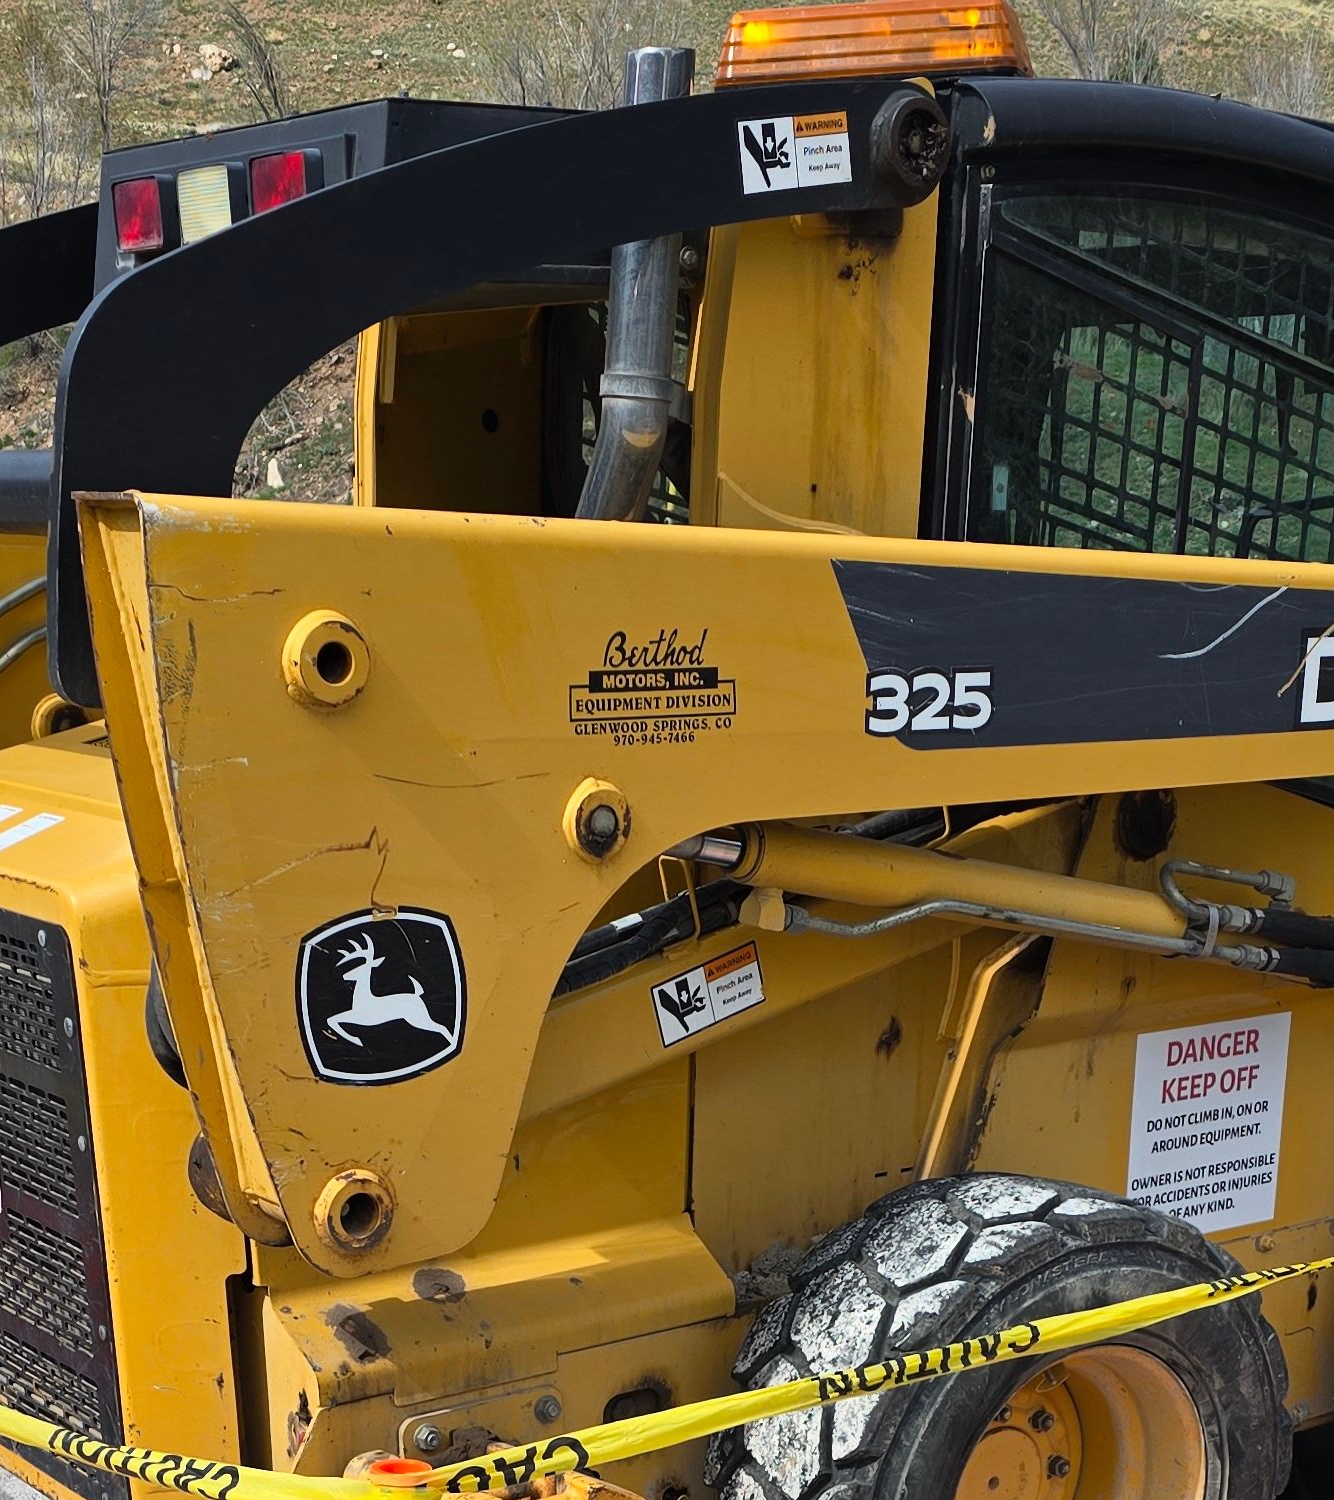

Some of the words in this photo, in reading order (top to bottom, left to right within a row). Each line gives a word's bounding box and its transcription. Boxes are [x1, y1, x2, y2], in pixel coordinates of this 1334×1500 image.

[805, 119, 843, 132] WARNING
[803, 145, 824, 156] Pinch
[826, 143, 843, 154] Area
[603, 628, 708, 668] Berthod
[602, 672, 669, 689] MOTORS,
[674, 671, 704, 687] INC.
[575, 696, 661, 715] EQUIPMENT
[666, 693, 731, 709] DIVISION
[869, 672, 992, 732] 325
[574, 720, 648, 736] GLENWOOD
[715, 717, 732, 730] CO
[613, 731, 695, 747] 970-945-7466
[716, 951, 752, 973] WARNING
[716, 980, 736, 994] Pinch
[737, 973, 753, 985] Area
[1167, 1028, 1260, 1067] DANGER
[1161, 1072, 1216, 1104] KEEP
[1220, 1065, 1260, 1094] OFF
[1147, 1119, 1163, 1133] DO
[1165, 1114, 1186, 1130] NOT
[1188, 1109, 1219, 1126] CLIMB
[1221, 1106, 1235, 1121] IN,
[1237, 1103, 1253, 1117] ON
[1254, 1100, 1269, 1114] OR
[1151, 1131, 1198, 1154] AROUND
[1200, 1122, 1261, 1146] EQUIPMENT.
[1131, 1171, 1172, 1191] OWNER
[1174, 1170, 1183, 1184] IS
[1185, 1165, 1206, 1181] NOT
[1208, 1153, 1276, 1177] RESPONSIBLE
[1153, 1184, 1211, 1206] ACCIDENTS
[1212, 1180, 1226, 1194] OR
[1228, 1172, 1273, 1191] INJURIES
[1183, 1202, 1207, 1218] ANY
[1207, 1197, 1235, 1214] KIND.
